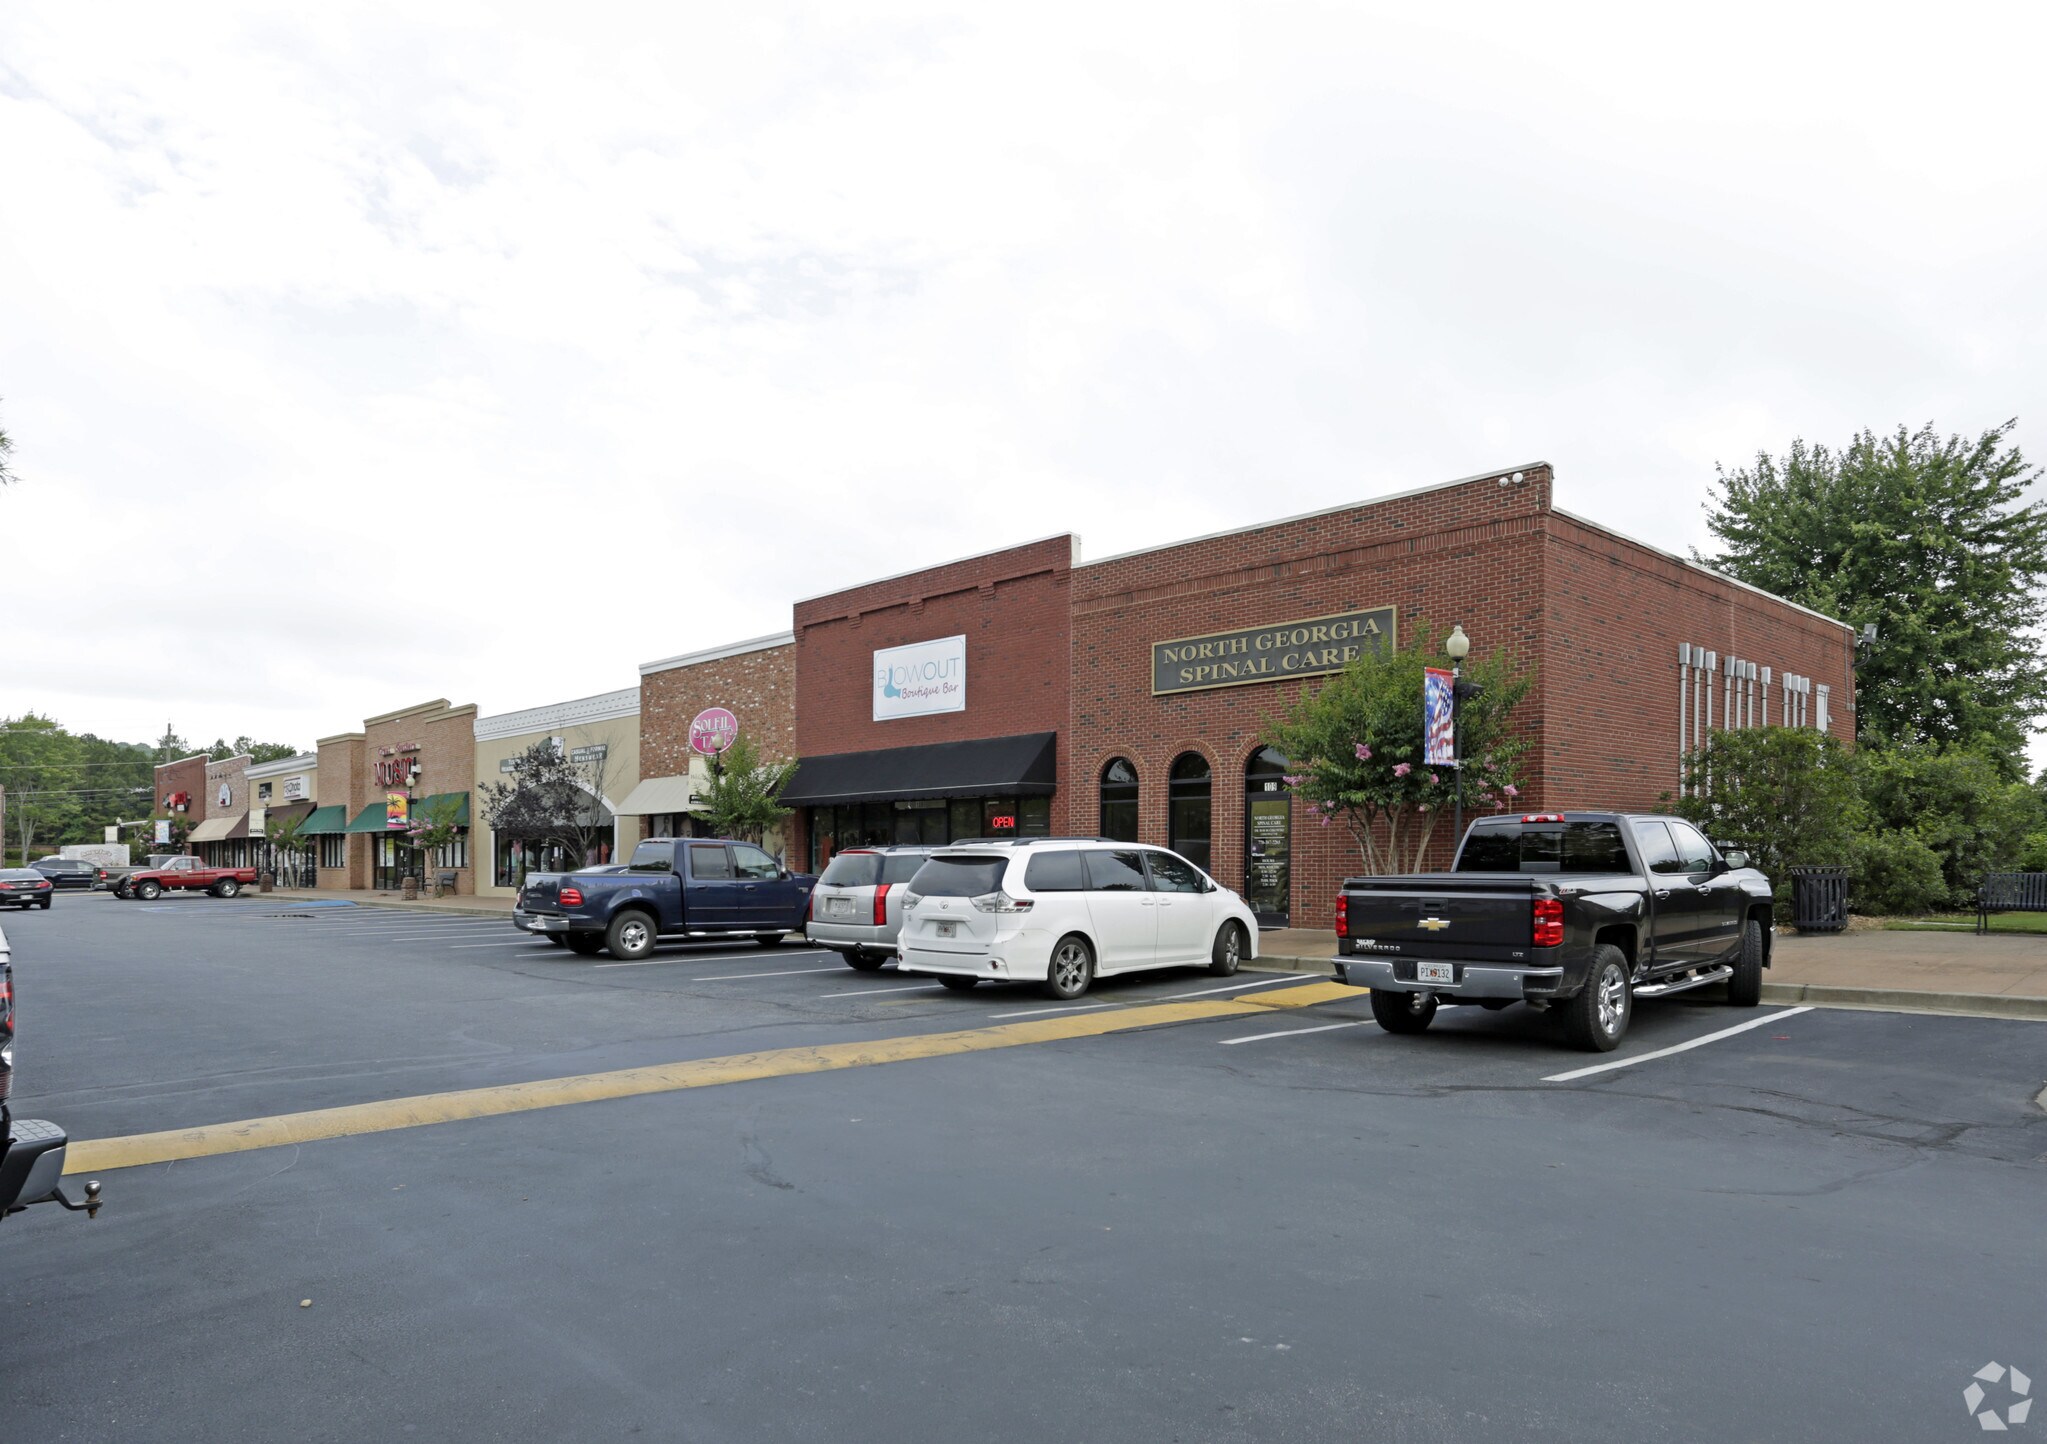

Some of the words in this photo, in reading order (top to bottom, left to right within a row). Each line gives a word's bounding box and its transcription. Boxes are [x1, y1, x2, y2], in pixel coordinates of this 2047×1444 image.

[1162, 637, 1248, 664] NORTH
[1255, 617, 1382, 651] GEORGIA
[1179, 657, 1276, 684] SPINAL
[1281, 644, 1361, 671] CARE
[901, 684, 941, 700] Boutique
[942, 681, 959, 695] Bar
[693, 716, 732, 738] SOLEIL
[993, 816, 1015, 828] OPEN
